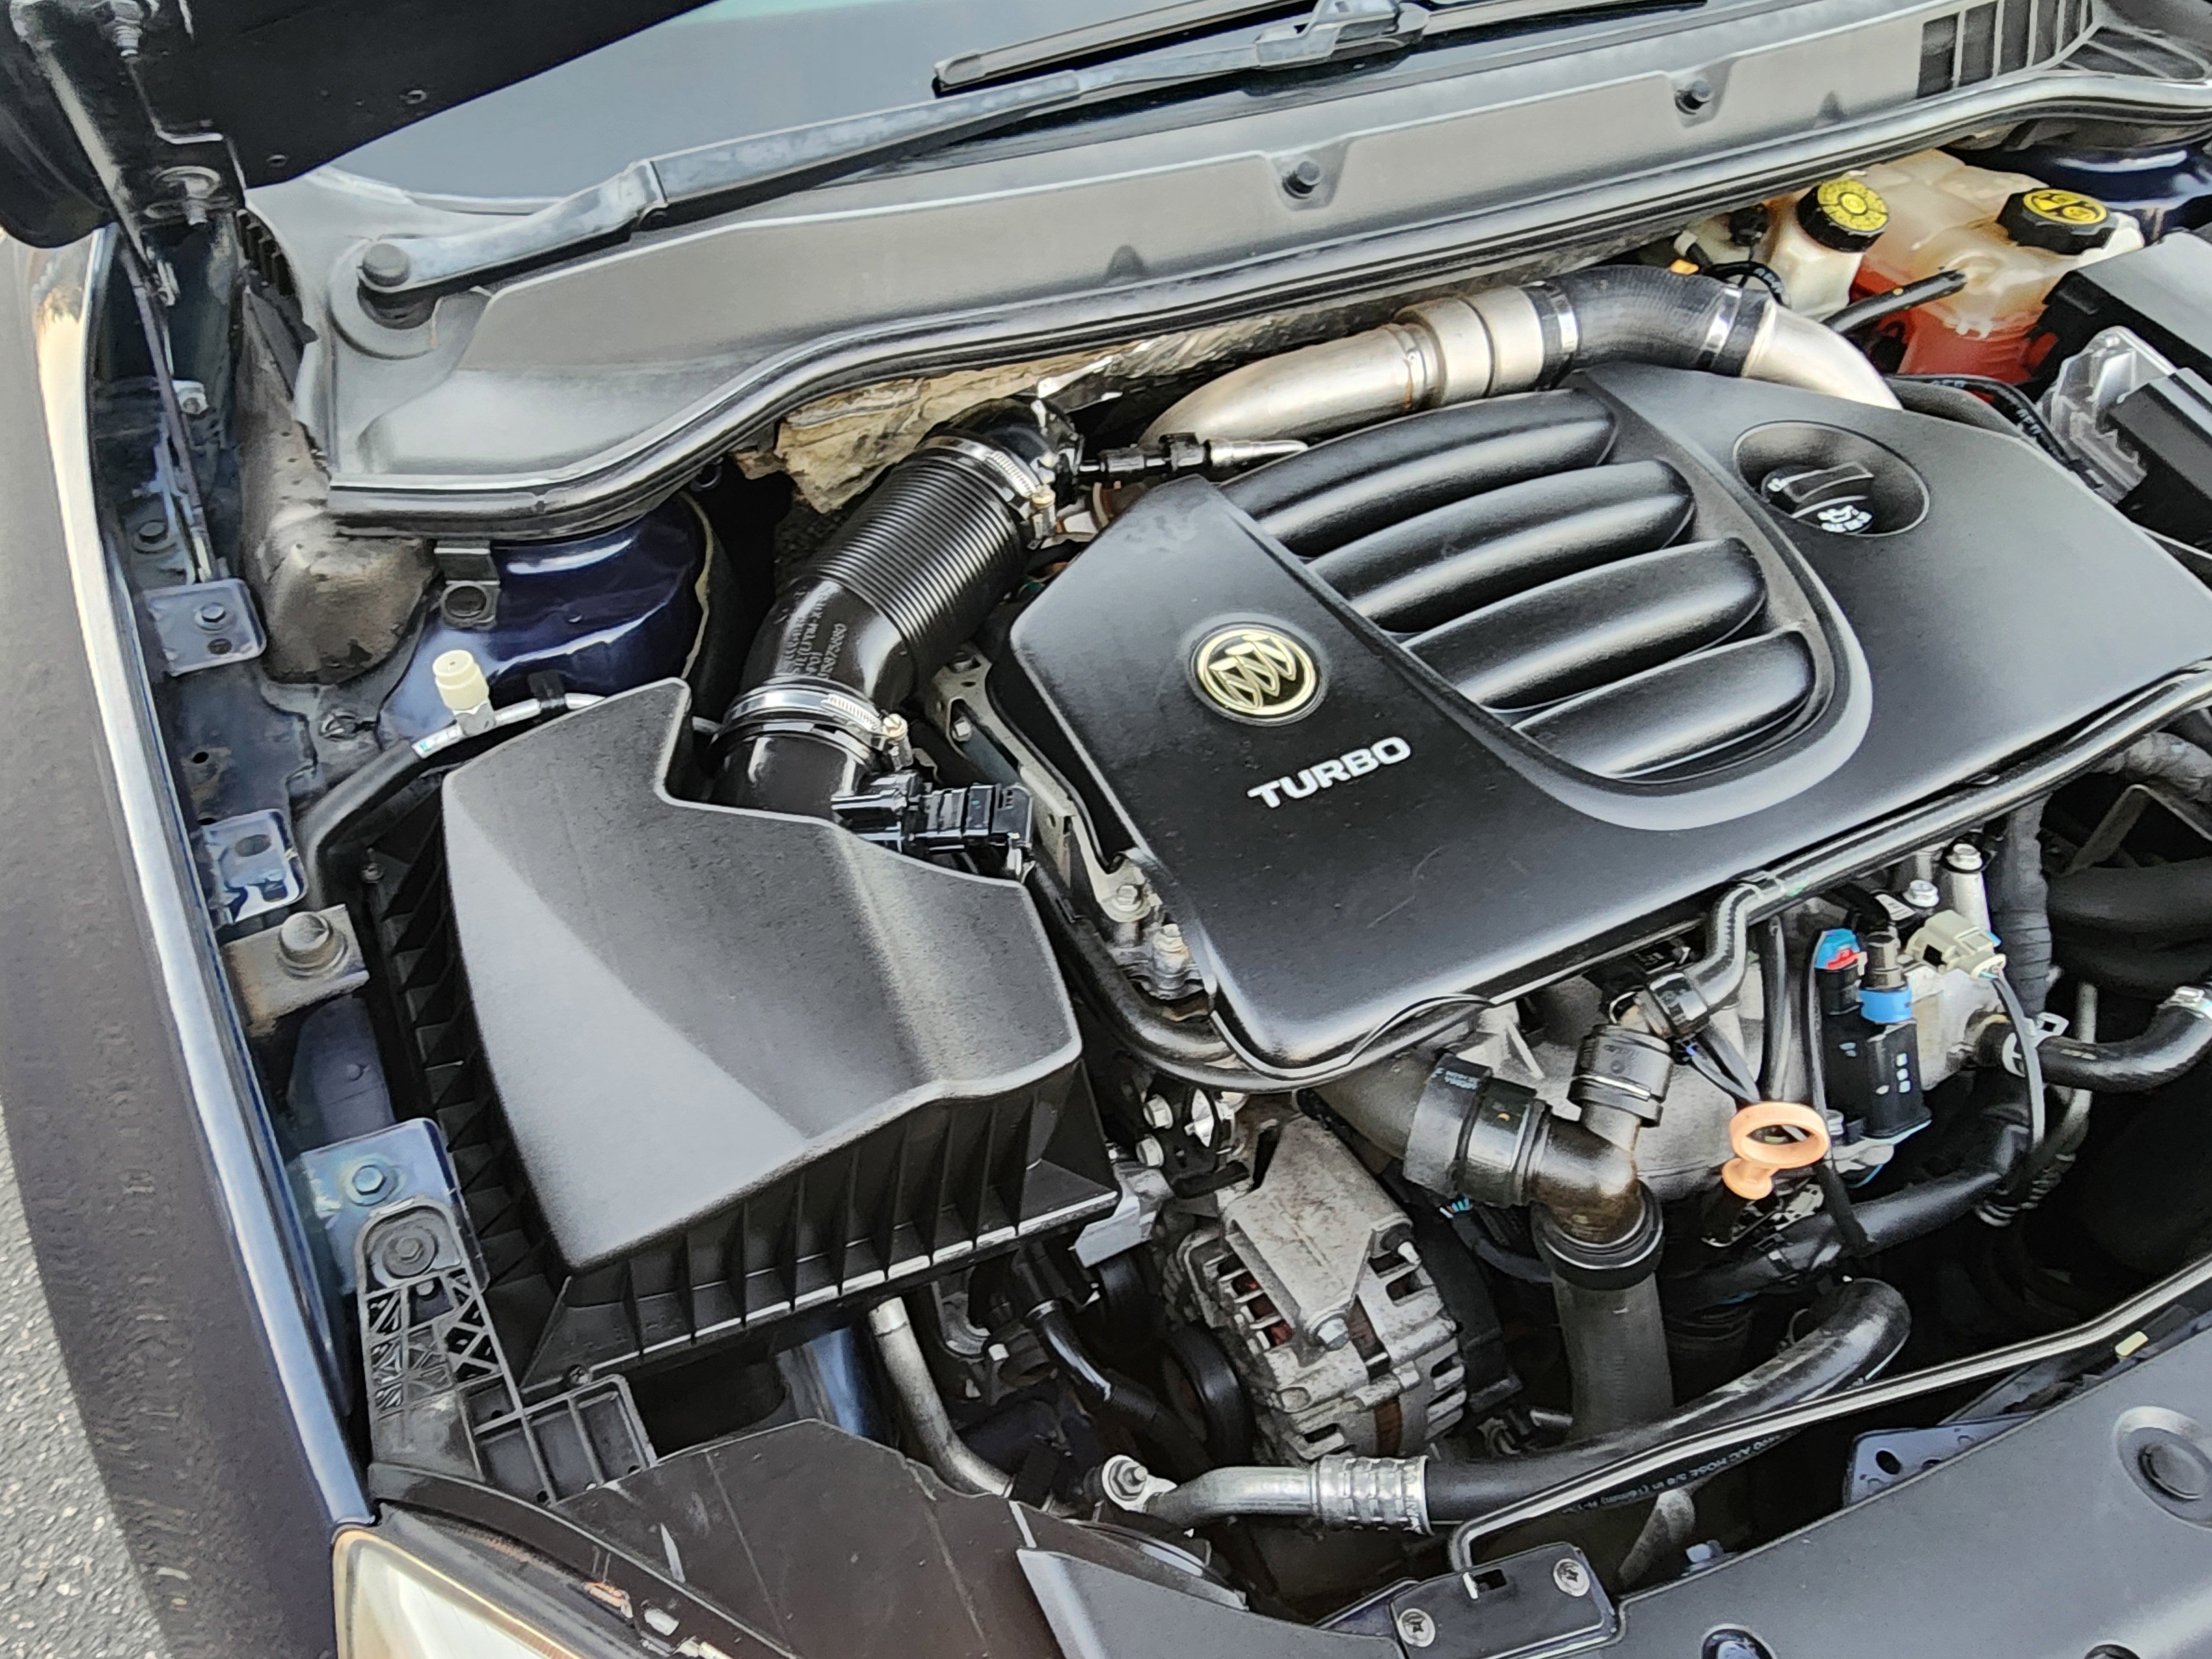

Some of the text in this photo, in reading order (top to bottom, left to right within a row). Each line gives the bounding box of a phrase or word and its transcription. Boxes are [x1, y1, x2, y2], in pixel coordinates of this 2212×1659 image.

[1247, 737, 1411, 808] TURBO
[1729, 1446, 1751, 1462] A/C
[1688, 1458, 1726, 1477] HOSE
